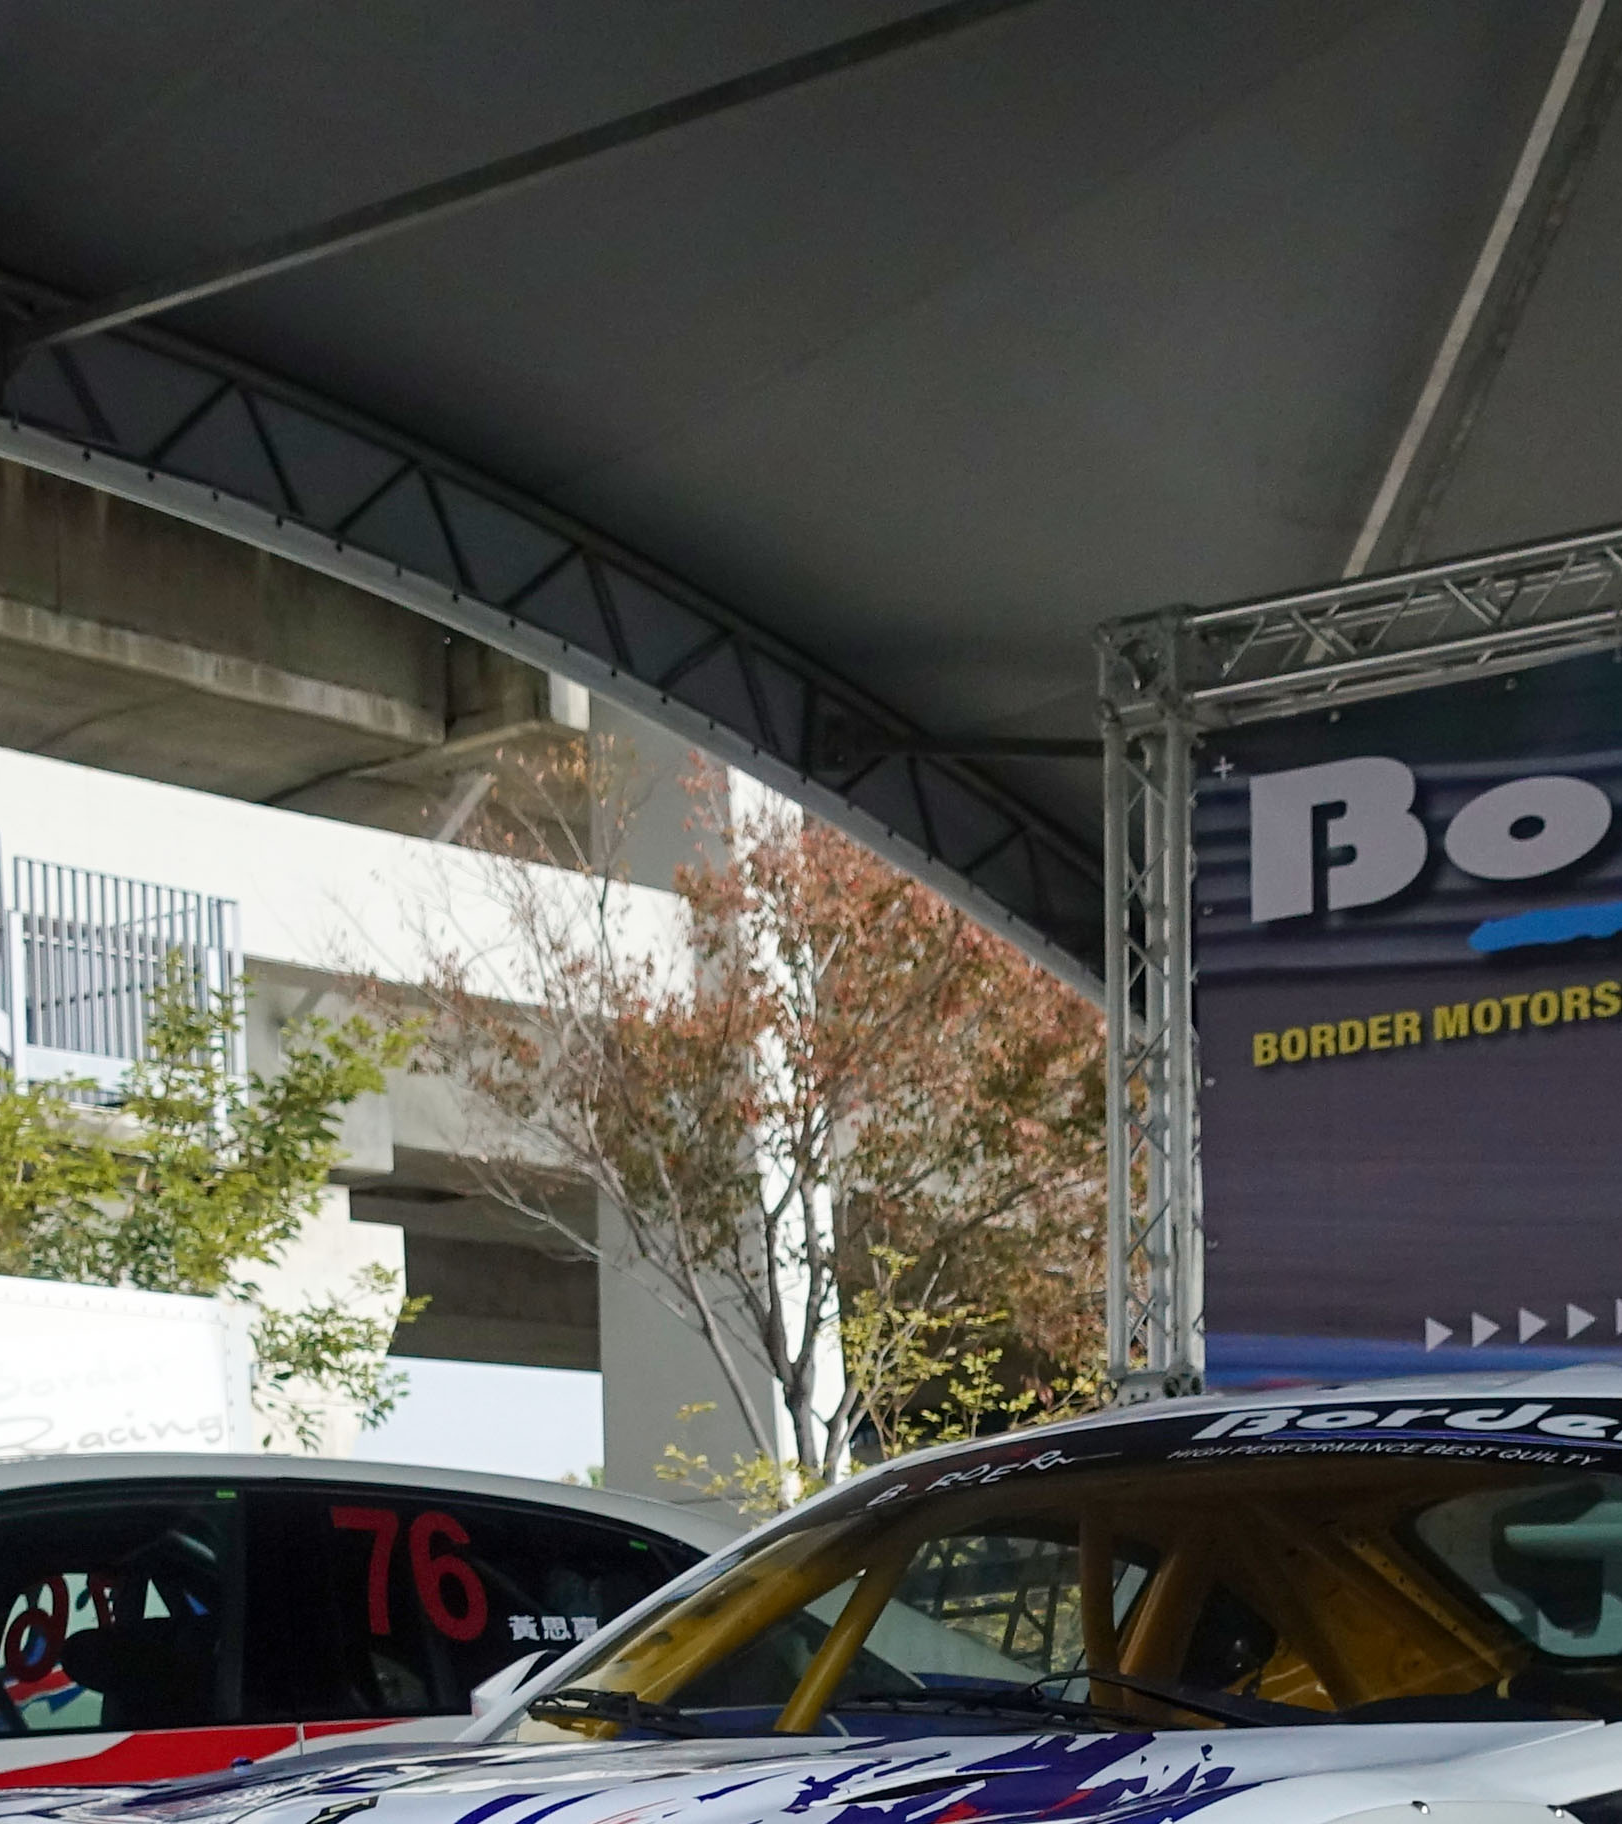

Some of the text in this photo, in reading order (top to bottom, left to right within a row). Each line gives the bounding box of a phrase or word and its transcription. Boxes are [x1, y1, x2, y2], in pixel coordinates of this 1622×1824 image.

[1252, 1011, 1421, 1067] BORDER
[1231, 1441, 1425, 1455] PERFORMANCE
[331, 1506, 488, 1642] 76
